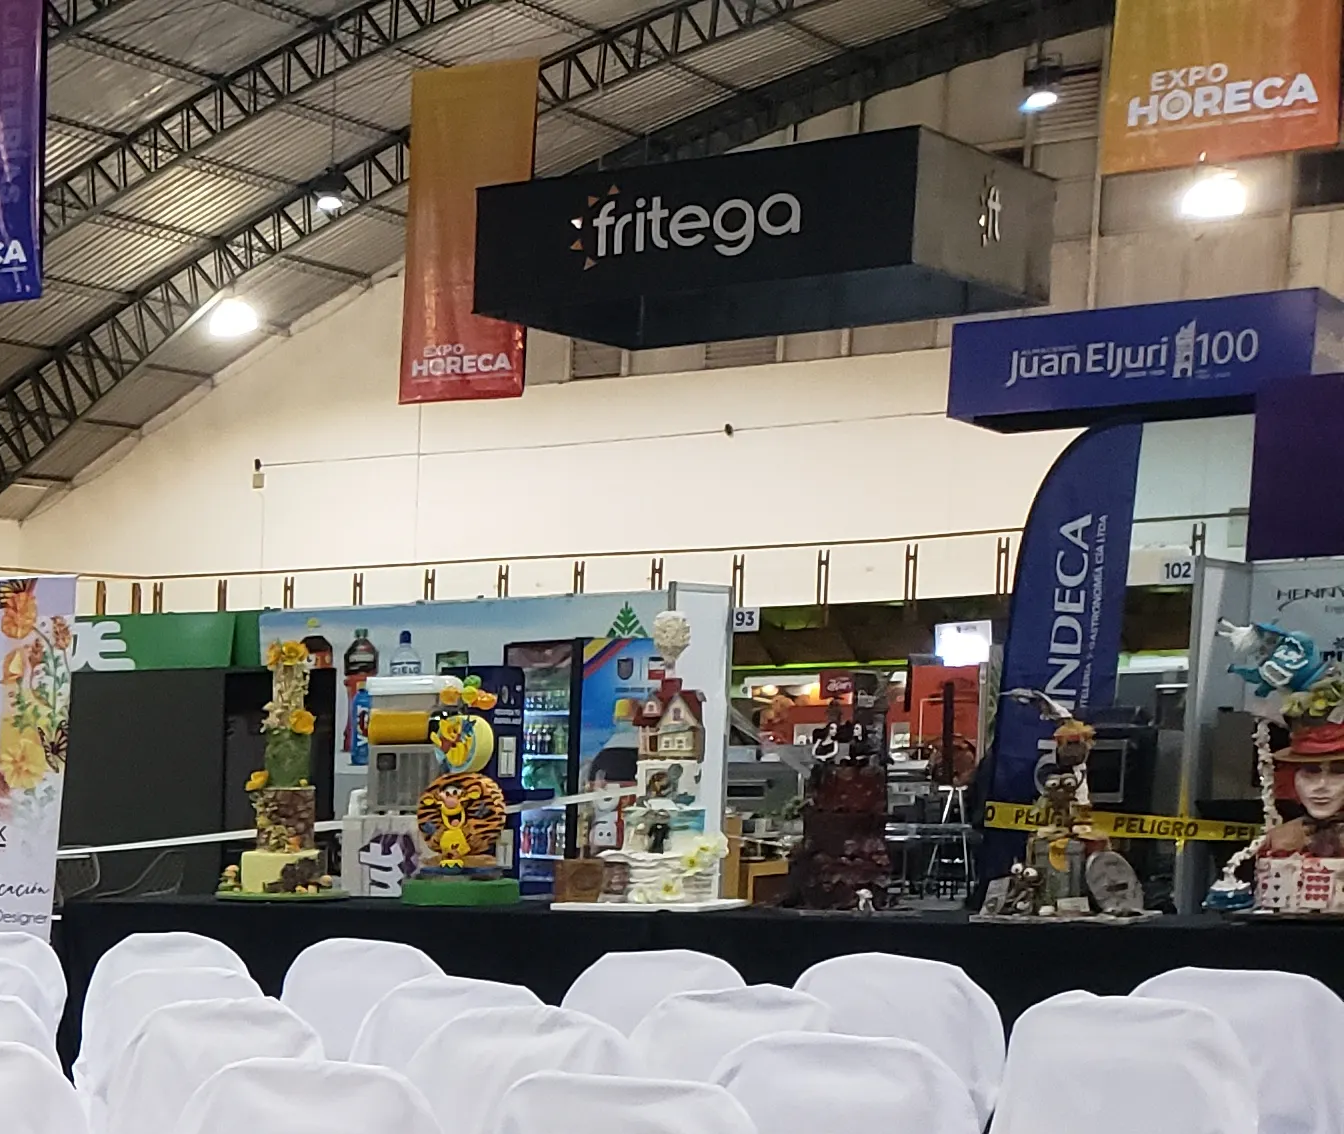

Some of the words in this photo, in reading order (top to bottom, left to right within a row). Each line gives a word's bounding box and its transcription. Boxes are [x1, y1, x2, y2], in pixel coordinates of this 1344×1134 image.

[1150, 63, 1229, 92] EXPO
[1127, 73, 1319, 127] HORECA
[592, 191, 802, 258] fritega
[423, 343, 466, 359] EXPO
[1005, 349, 1081, 388] Juan
[1196, 327, 1259, 367] 100
[411, 352, 512, 377] HORECA
[1164, 562, 1192, 579] 102
[735, 611, 755, 627] 93
[1113, 816, 1199, 838] PELIGRO
